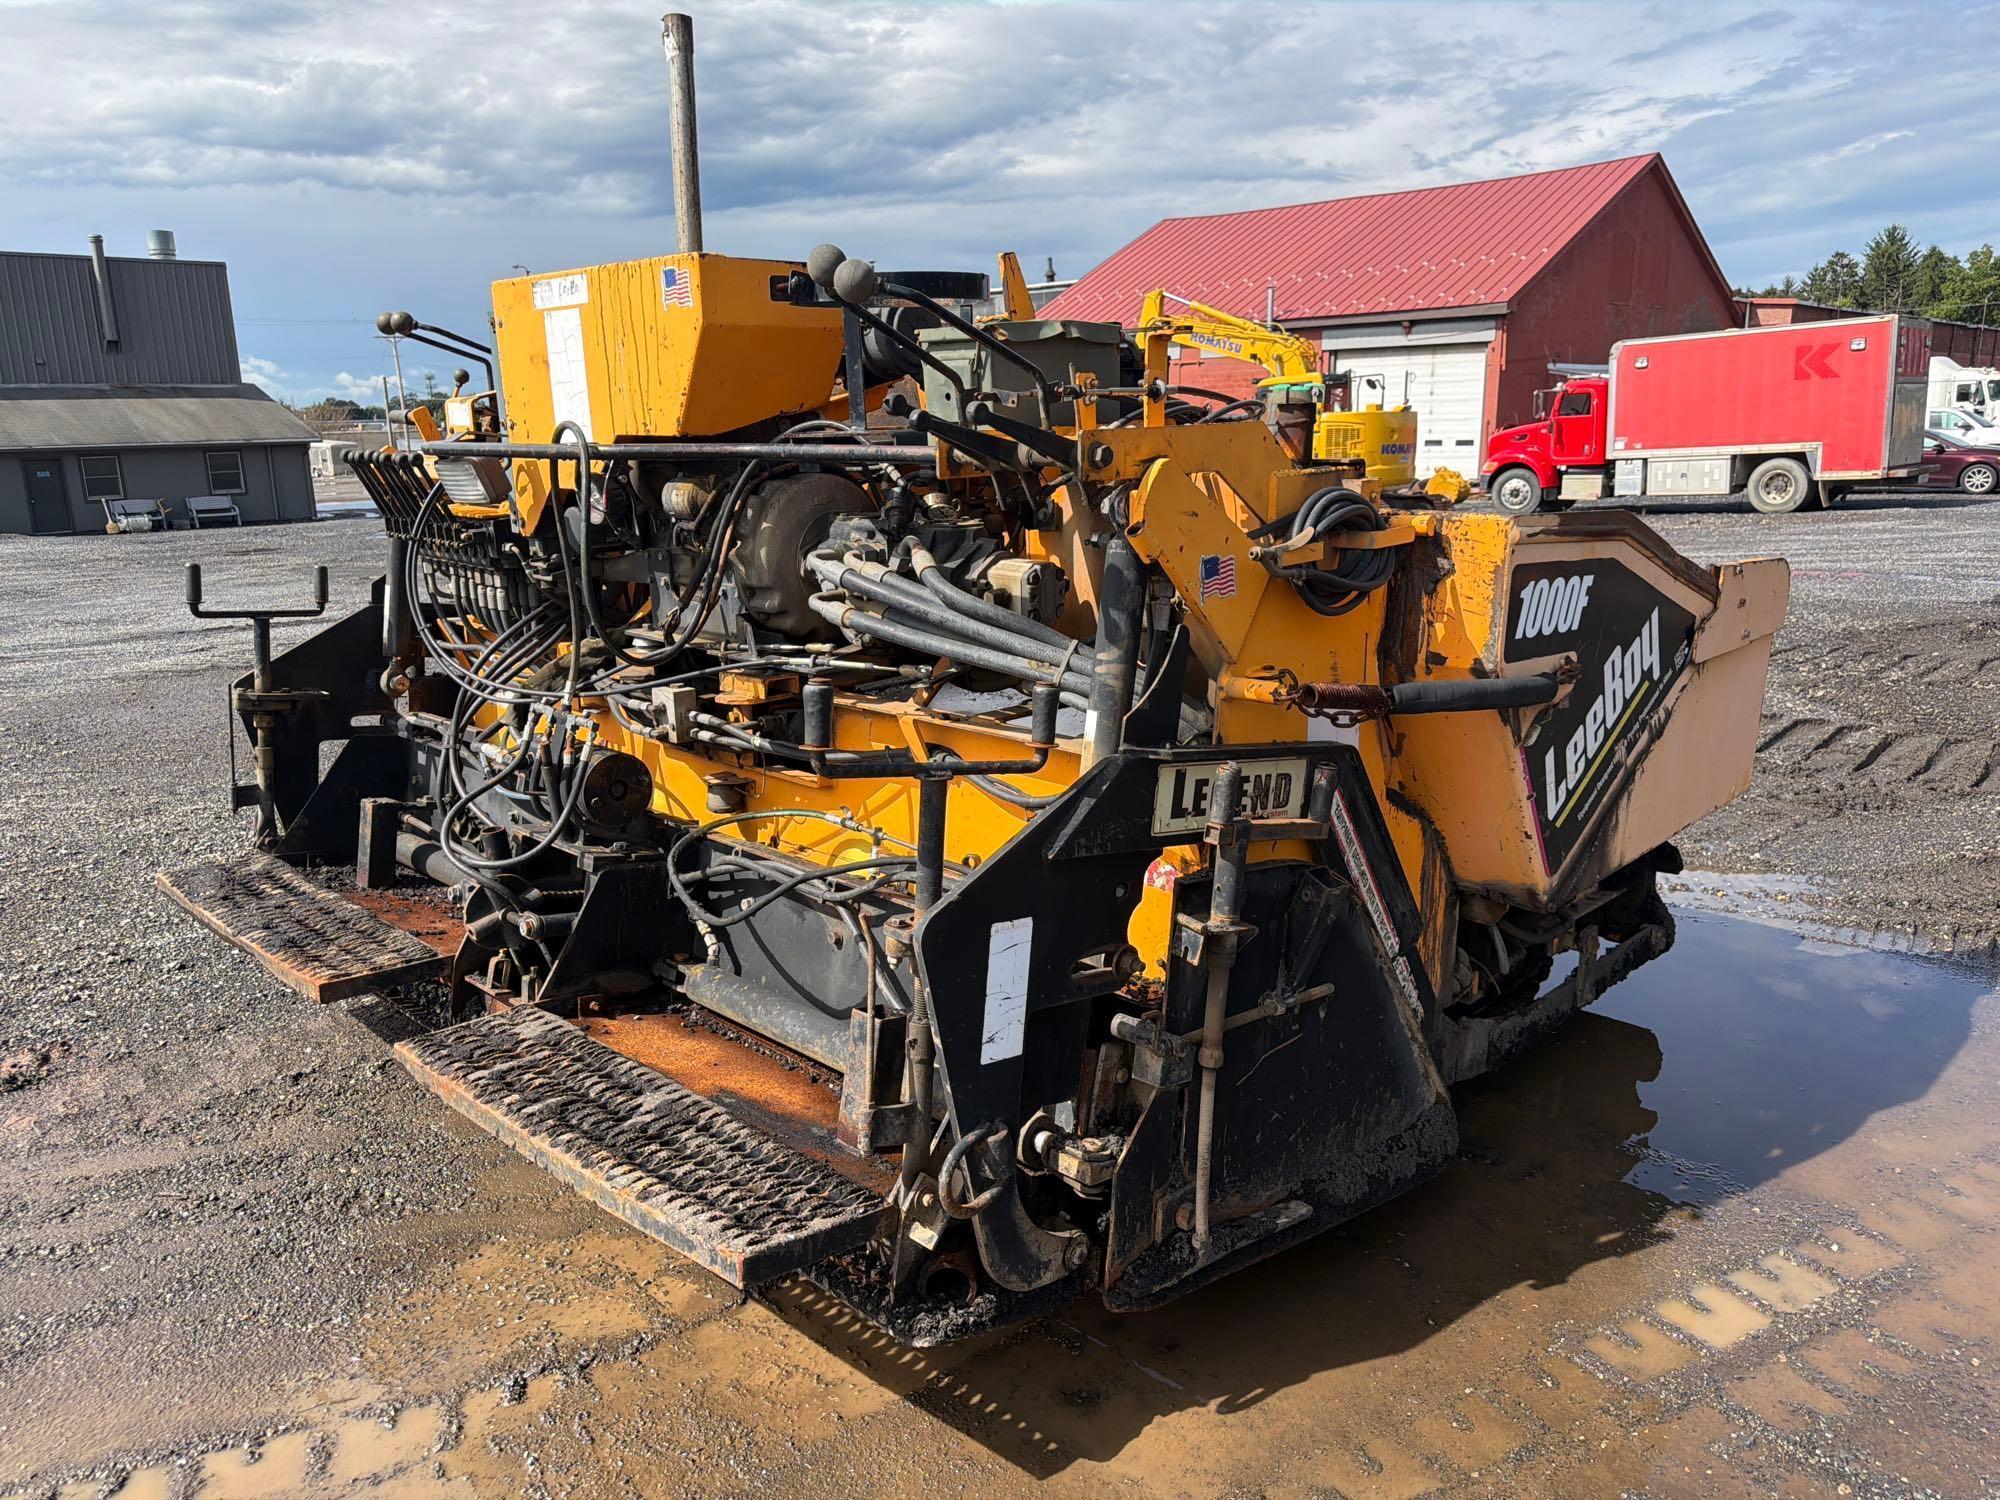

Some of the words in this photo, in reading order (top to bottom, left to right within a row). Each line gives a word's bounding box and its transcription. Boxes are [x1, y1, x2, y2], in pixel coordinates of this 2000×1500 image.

[1190, 332, 1242, 353] KOMATSU
[1793, 341, 1842, 381] K
[1515, 575, 1594, 640] 1000F
[1545, 606, 1660, 821] LeeBoy
[1171, 769, 1292, 819] LEEND
